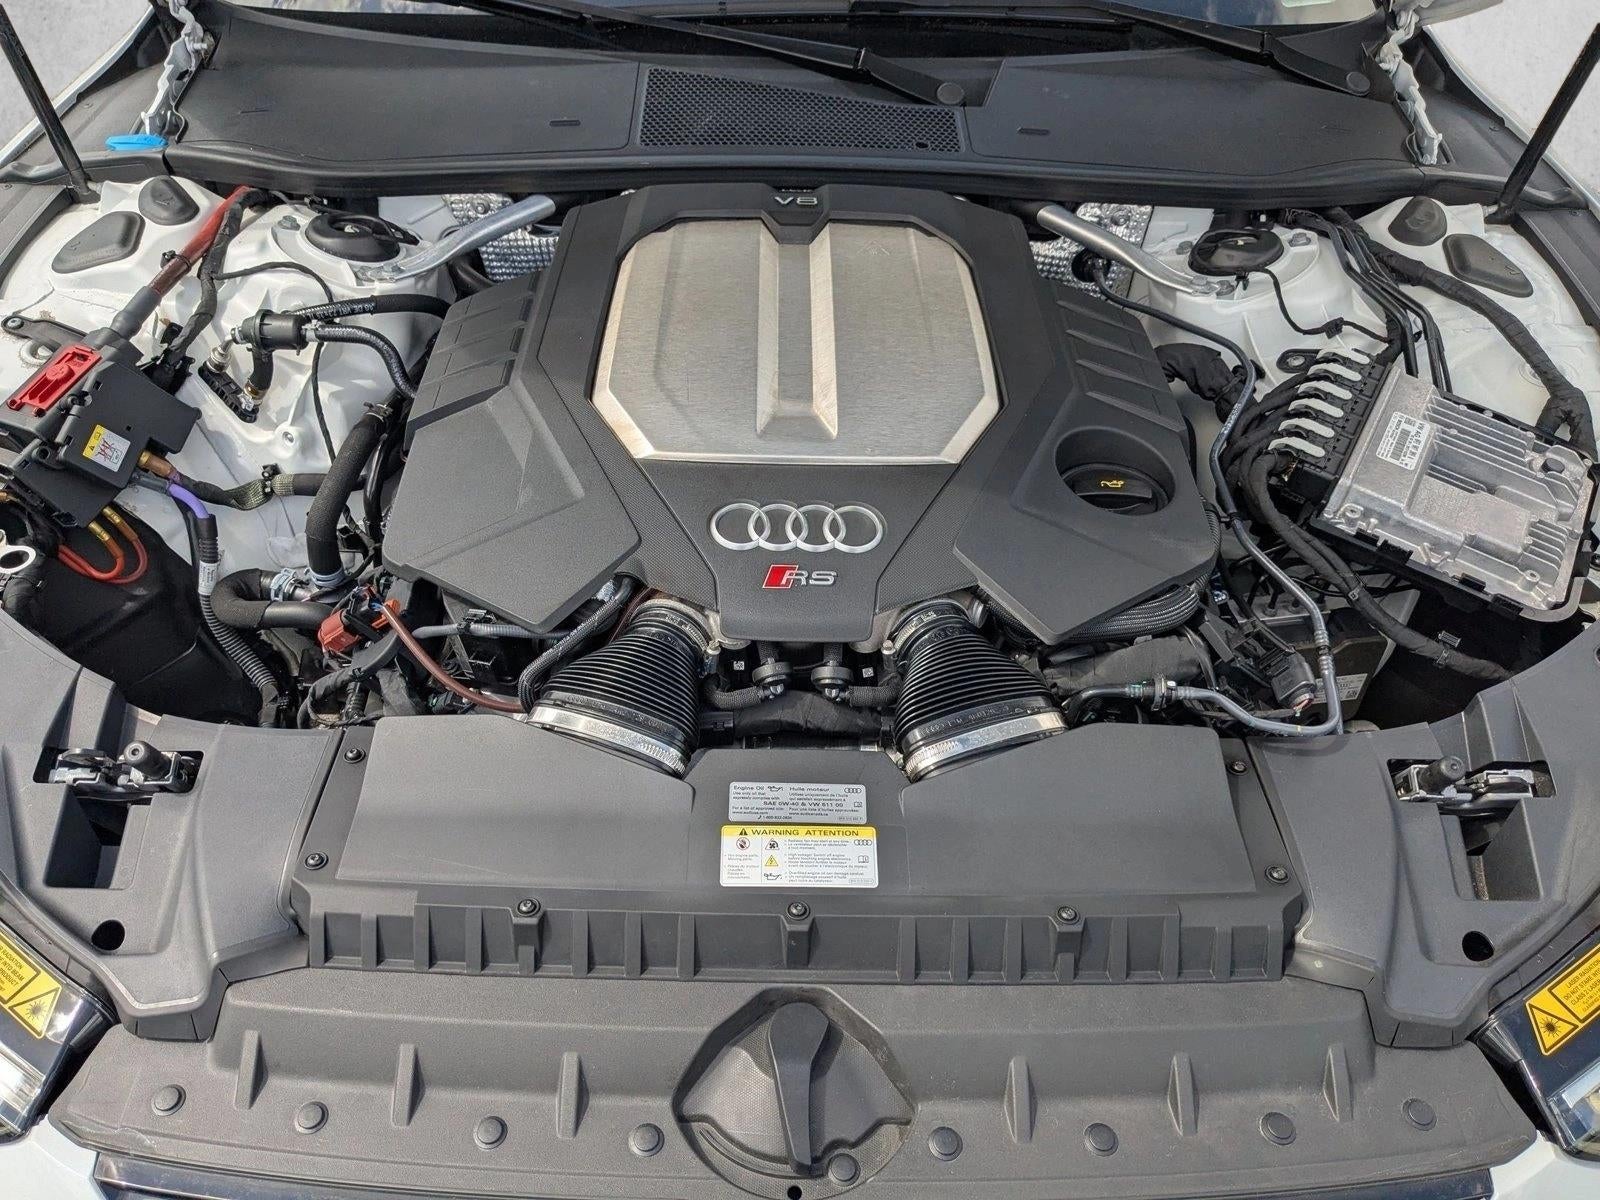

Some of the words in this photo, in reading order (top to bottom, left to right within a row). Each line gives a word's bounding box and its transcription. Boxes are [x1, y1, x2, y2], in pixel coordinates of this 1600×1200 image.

[774, 196, 818, 205] V8
[779, 569, 838, 586] RS
[805, 829, 859, 837] ATTENTION
